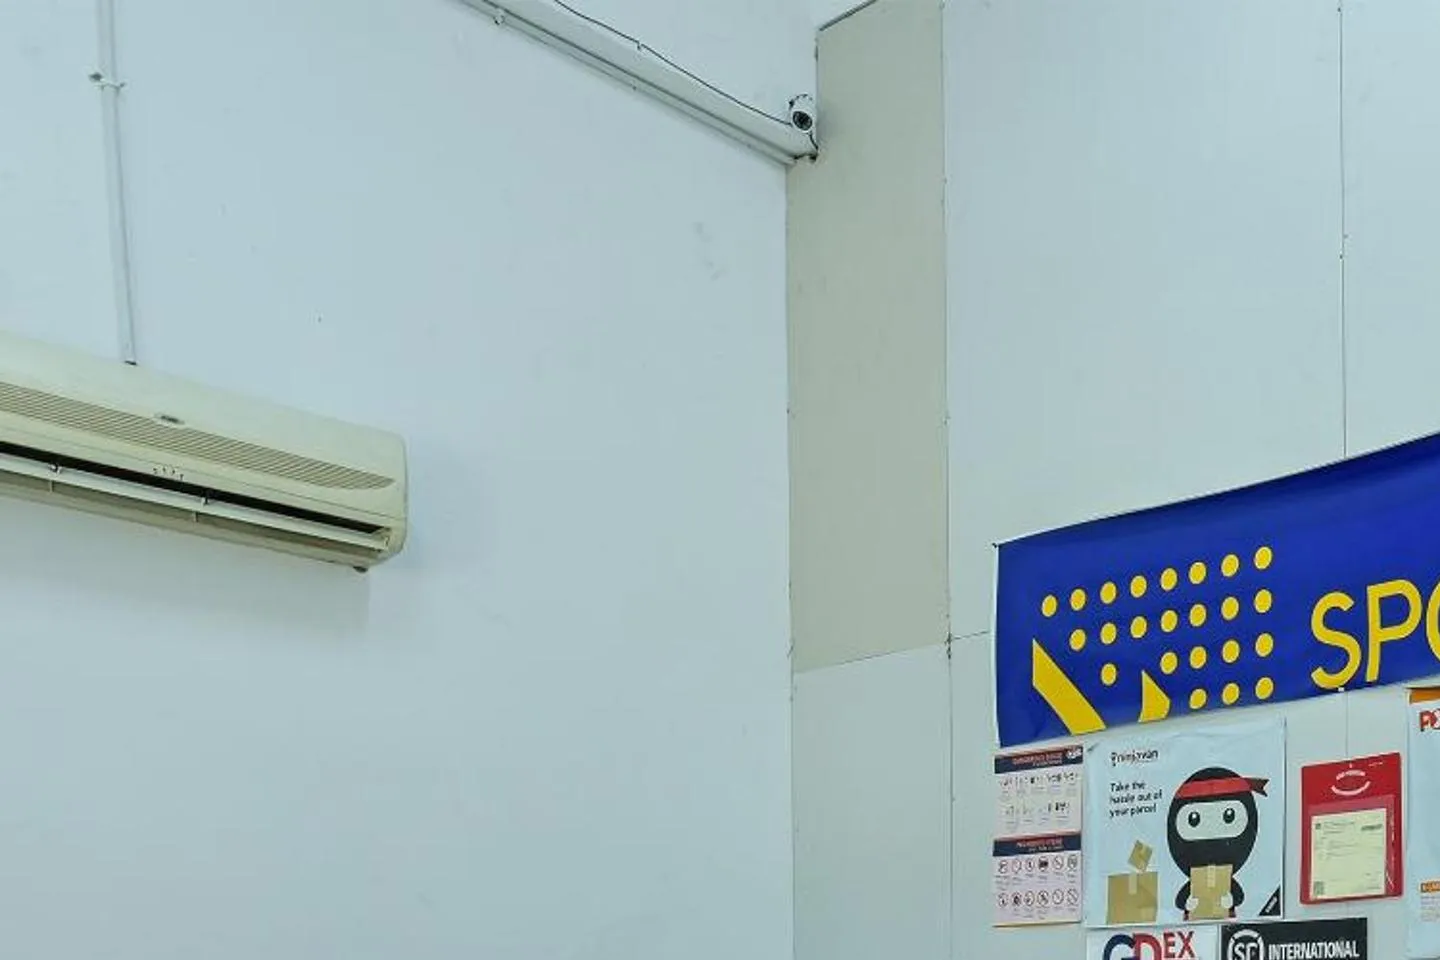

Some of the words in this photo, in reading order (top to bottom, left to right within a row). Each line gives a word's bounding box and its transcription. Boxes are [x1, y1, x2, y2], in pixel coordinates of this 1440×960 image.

[1110, 782, 1130, 792] Take
[1132, 782, 1146, 790] the
[1137, 792, 1152, 801] out
[1153, 788, 1162, 799] of
[1109, 807, 1129, 819] your
[1130, 803, 1157, 817] parcel
[1268, 939, 1360, 960] INTERNATIONAL
